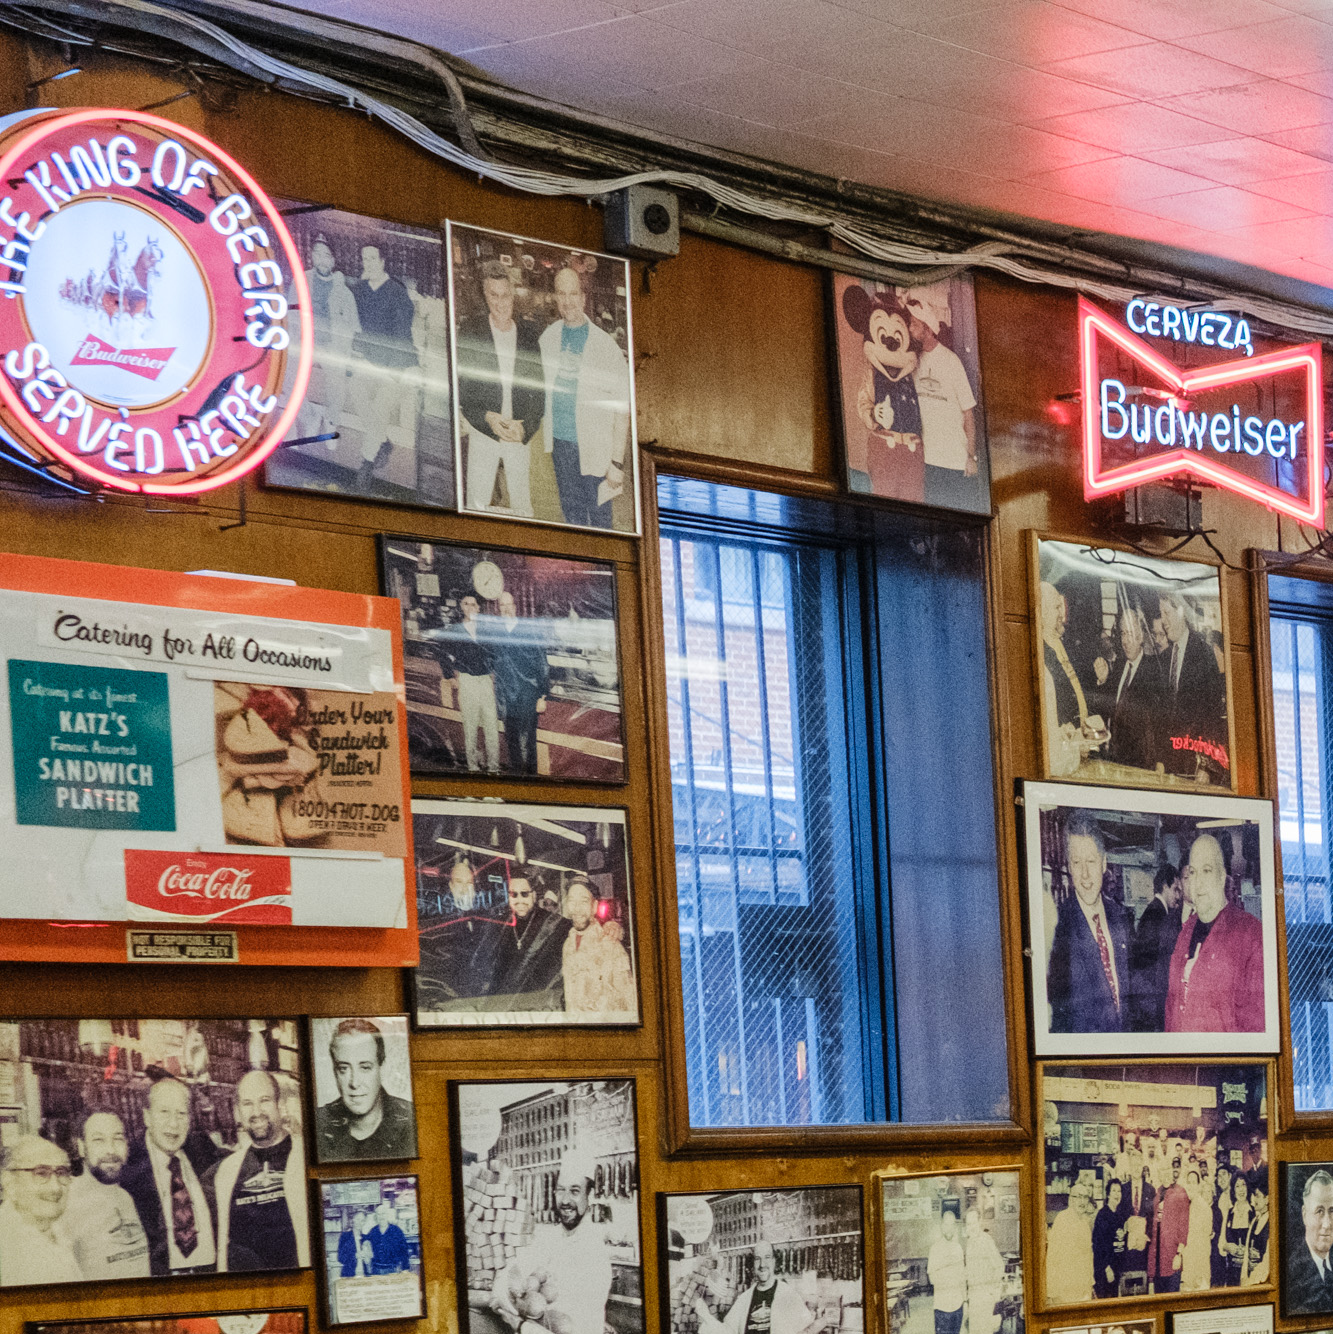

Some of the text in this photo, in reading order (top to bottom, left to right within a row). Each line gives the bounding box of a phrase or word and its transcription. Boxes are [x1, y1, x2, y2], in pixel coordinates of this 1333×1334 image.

[26, 136, 140, 212] KING
[151, 139, 218, 195] OF
[209, 193, 290, 350] BEERS
[1126, 298, 1254, 357] CERVEZA
[81, 337, 167, 372] Budweiser
[6, 342, 277, 474] SERVED HERE
[1100, 378, 1305, 461] Budweiser
[54, 612, 333, 673] Catering for All Occasions
[58, 710, 130, 738] KATZ'S
[295, 700, 395, 727] Order Your
[307, 726, 390, 751] Sandwich
[38, 757, 154, 787] SANDWICH
[316, 751, 383, 777] Platter!
[56, 786, 140, 813] PLATTER
[157, 864, 256, 900] Coca-Cola
